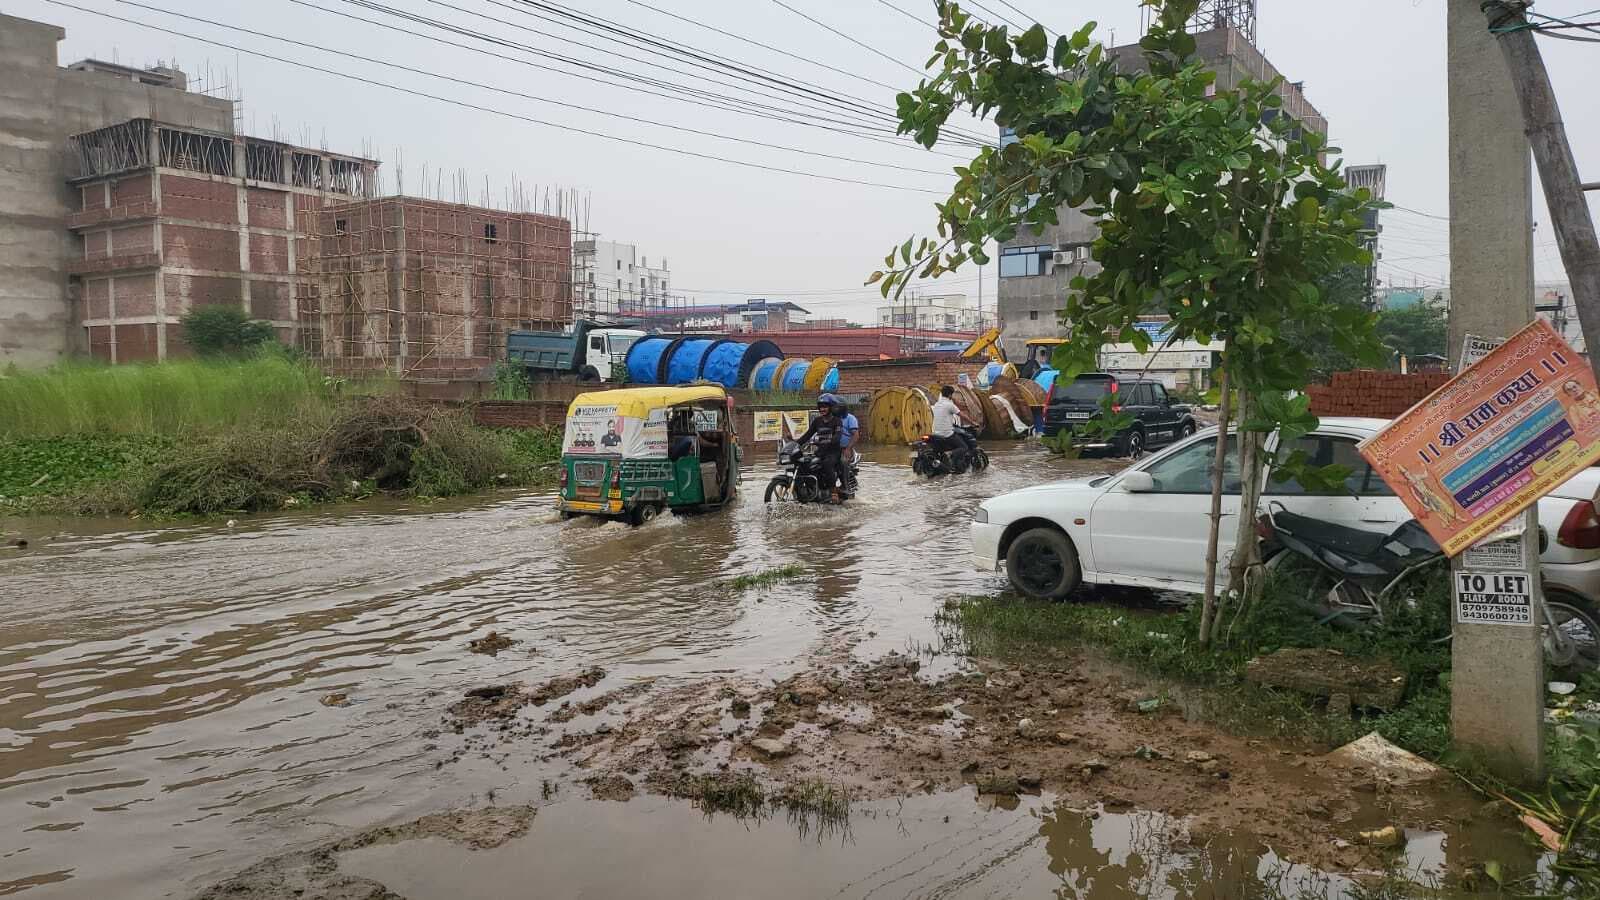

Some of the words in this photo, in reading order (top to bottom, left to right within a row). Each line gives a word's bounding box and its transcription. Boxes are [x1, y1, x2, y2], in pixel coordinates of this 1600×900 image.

[1438, 422, 1466, 447] श्री
[1461, 401, 1499, 431] राम
[1496, 369, 1542, 406] कथा
[1461, 575, 1486, 592] TO
[1493, 575, 1525, 593] LET
[1463, 594, 1487, 602] FLATS
[1498, 595, 1525, 604] ROOM
[1462, 603, 1528, 613] 8709758946
[1463, 611, 1529, 620] 9430600719
